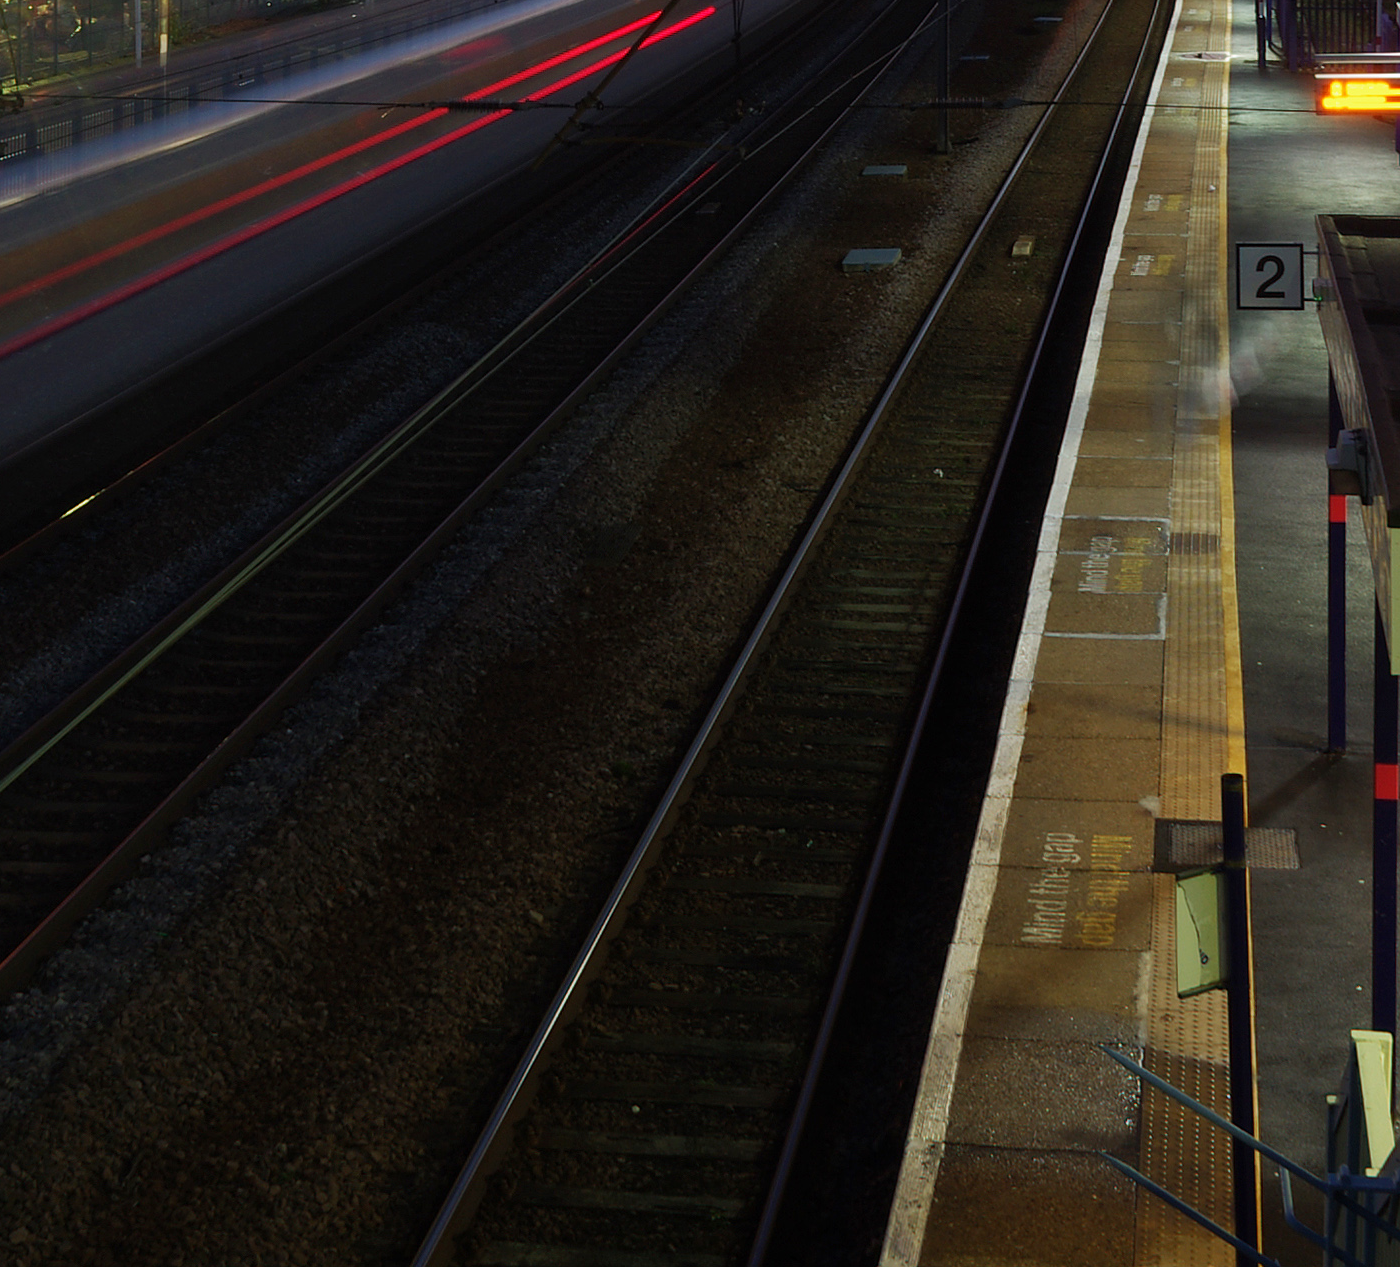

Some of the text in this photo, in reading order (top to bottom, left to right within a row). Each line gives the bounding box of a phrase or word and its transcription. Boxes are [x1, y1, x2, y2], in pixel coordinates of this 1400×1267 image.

[1255, 254, 1286, 299] 2
[1020, 832, 1084, 944] Mind the gap
